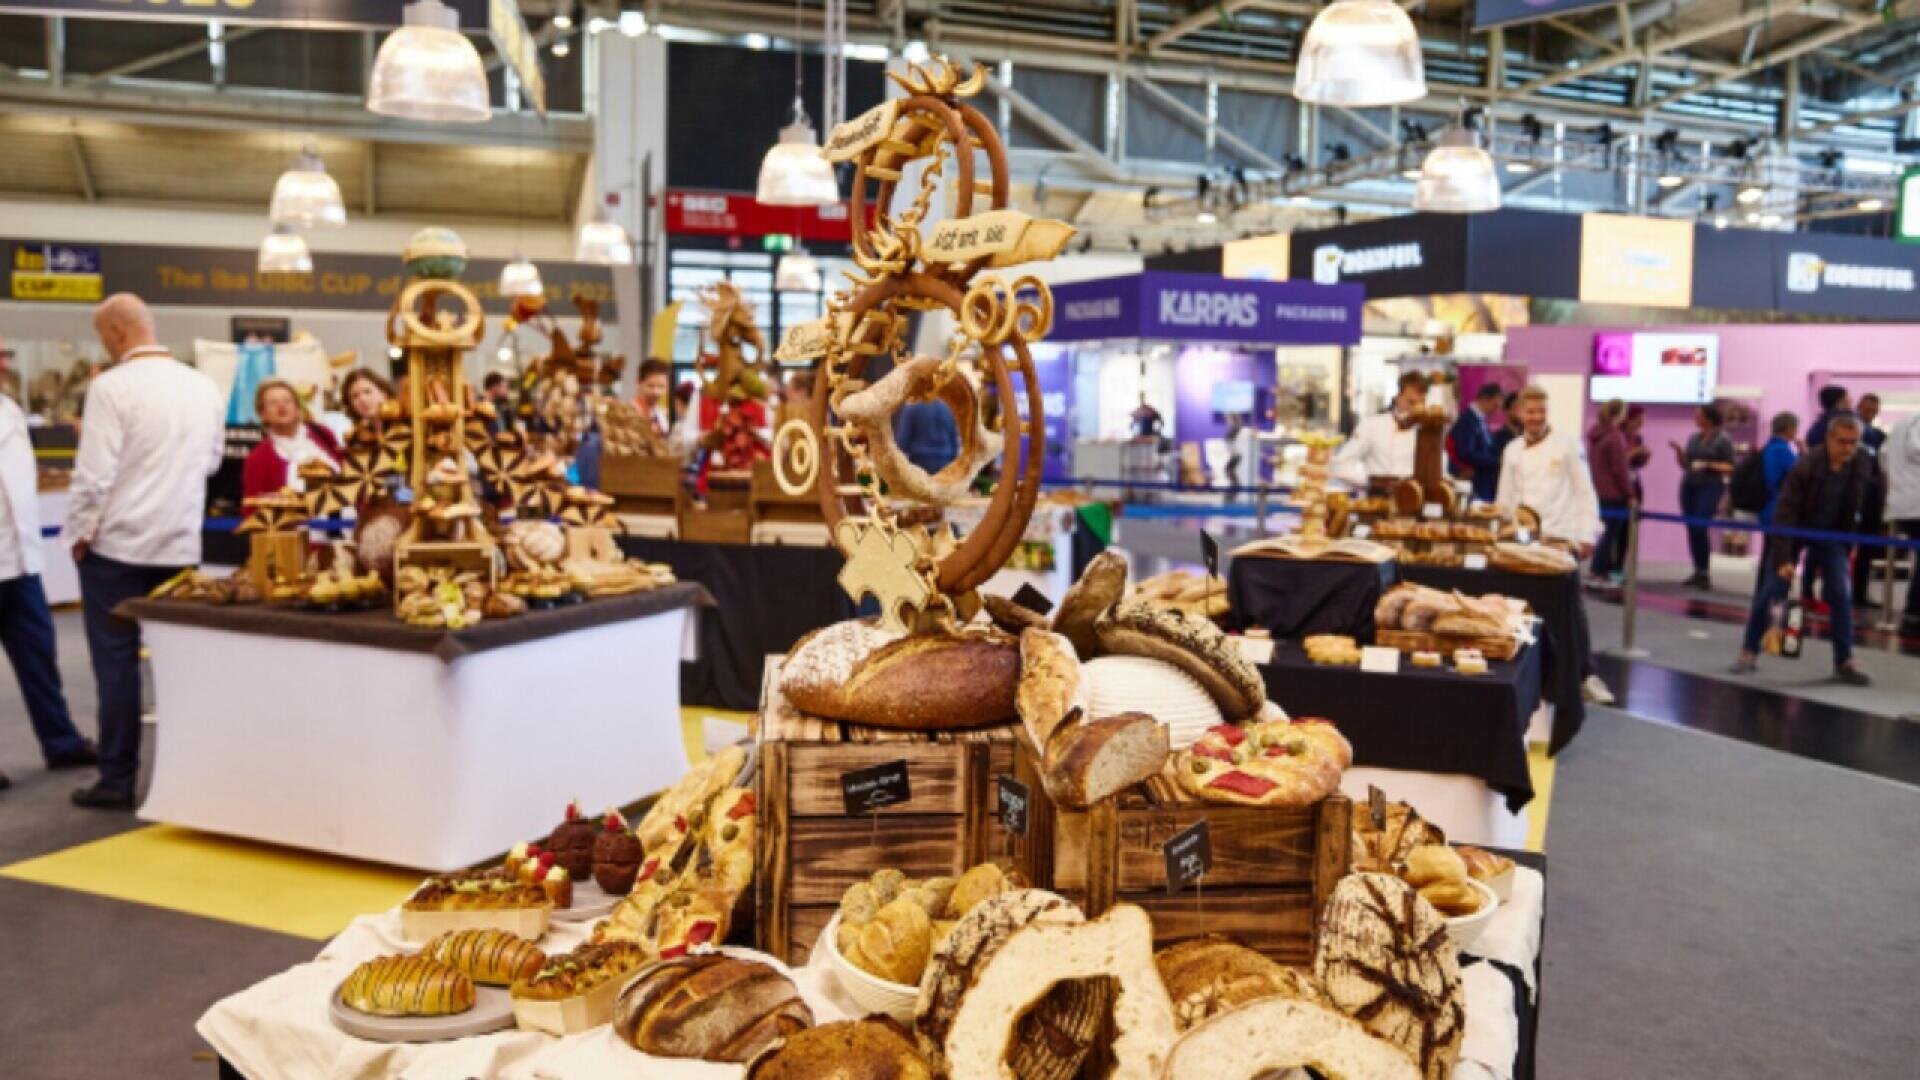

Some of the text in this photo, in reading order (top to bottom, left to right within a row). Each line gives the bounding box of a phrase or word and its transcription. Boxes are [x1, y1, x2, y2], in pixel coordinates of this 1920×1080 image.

[158, 265, 204, 289] The
[321, 272, 372, 296] CUP
[1160, 289, 1259, 327] KARPAS
[1275, 303, 1348, 323] PACKAGING
